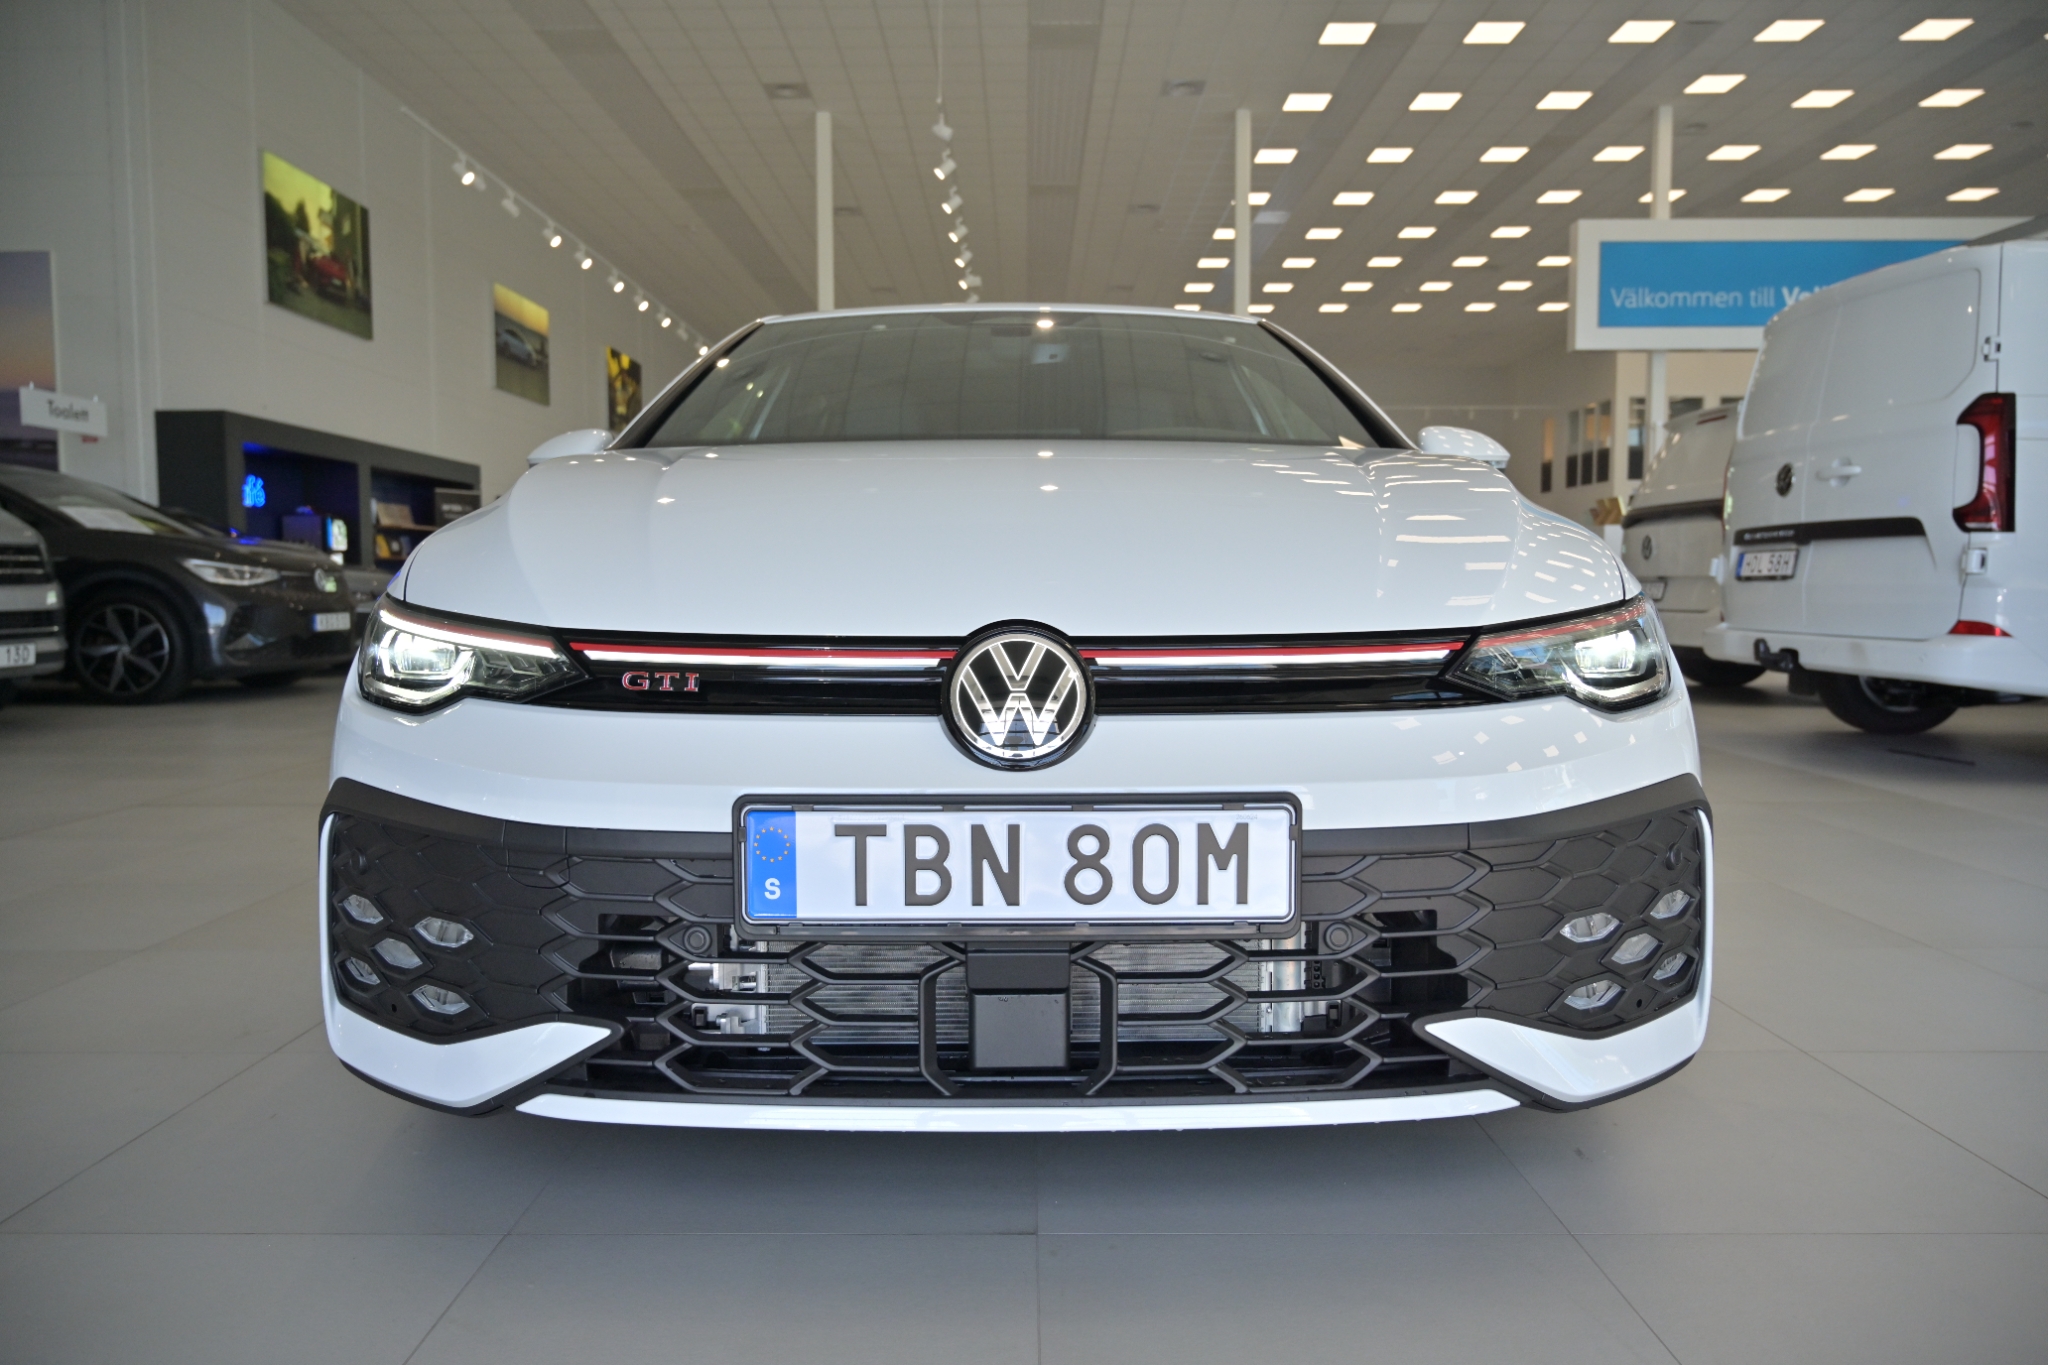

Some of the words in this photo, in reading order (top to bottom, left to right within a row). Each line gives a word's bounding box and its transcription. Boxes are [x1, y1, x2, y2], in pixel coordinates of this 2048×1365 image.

[1610, 286, 1743, 309] Välkommen
[1750, 286, 1776, 308] till
[622, 671, 699, 692] GTI
[834, 823, 1020, 907] TBN
[1064, 822, 1249, 906] 80M
[763, 877, 782, 901] S
